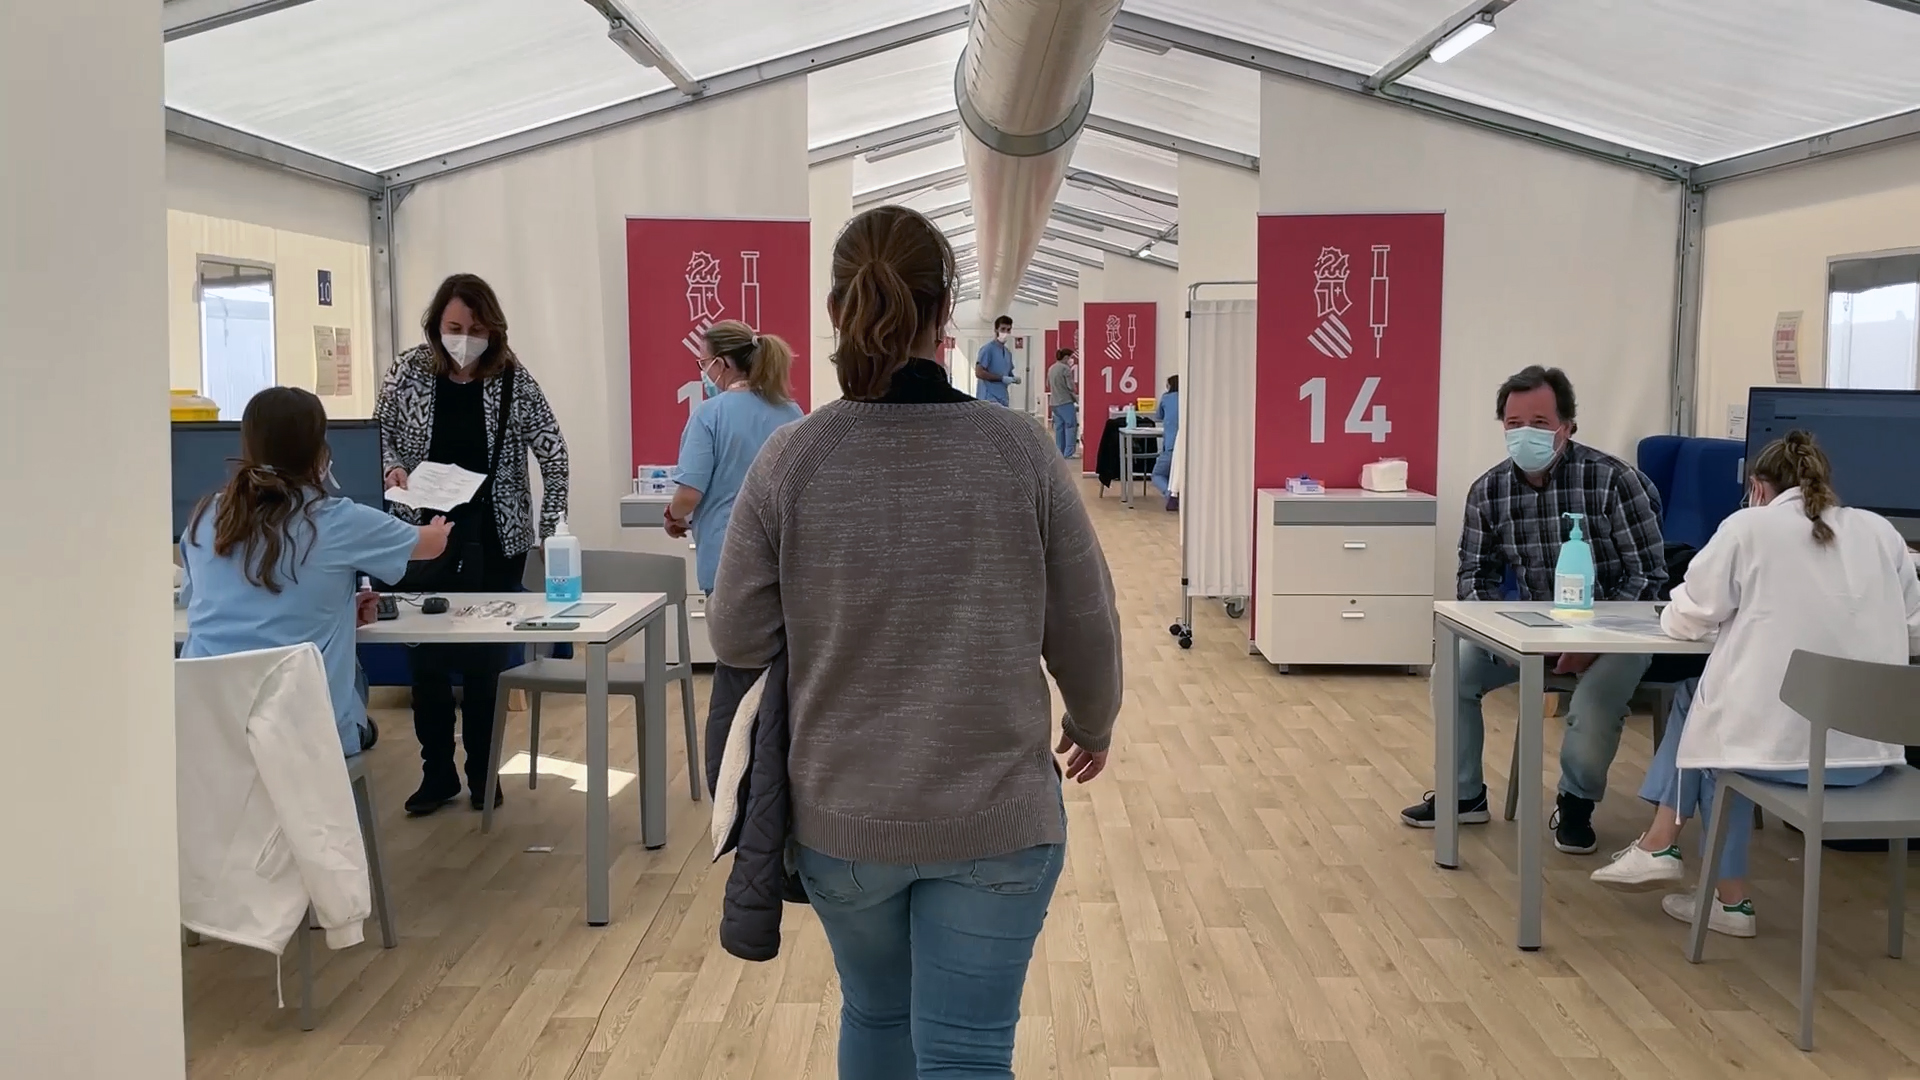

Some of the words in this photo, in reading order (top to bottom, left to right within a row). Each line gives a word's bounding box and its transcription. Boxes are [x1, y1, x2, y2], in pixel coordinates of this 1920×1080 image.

[1071, 364, 1079, 383] 1
[1101, 366, 1138, 394] 16
[677, 380, 704, 418] 1
[1299, 377, 1392, 443] 14
